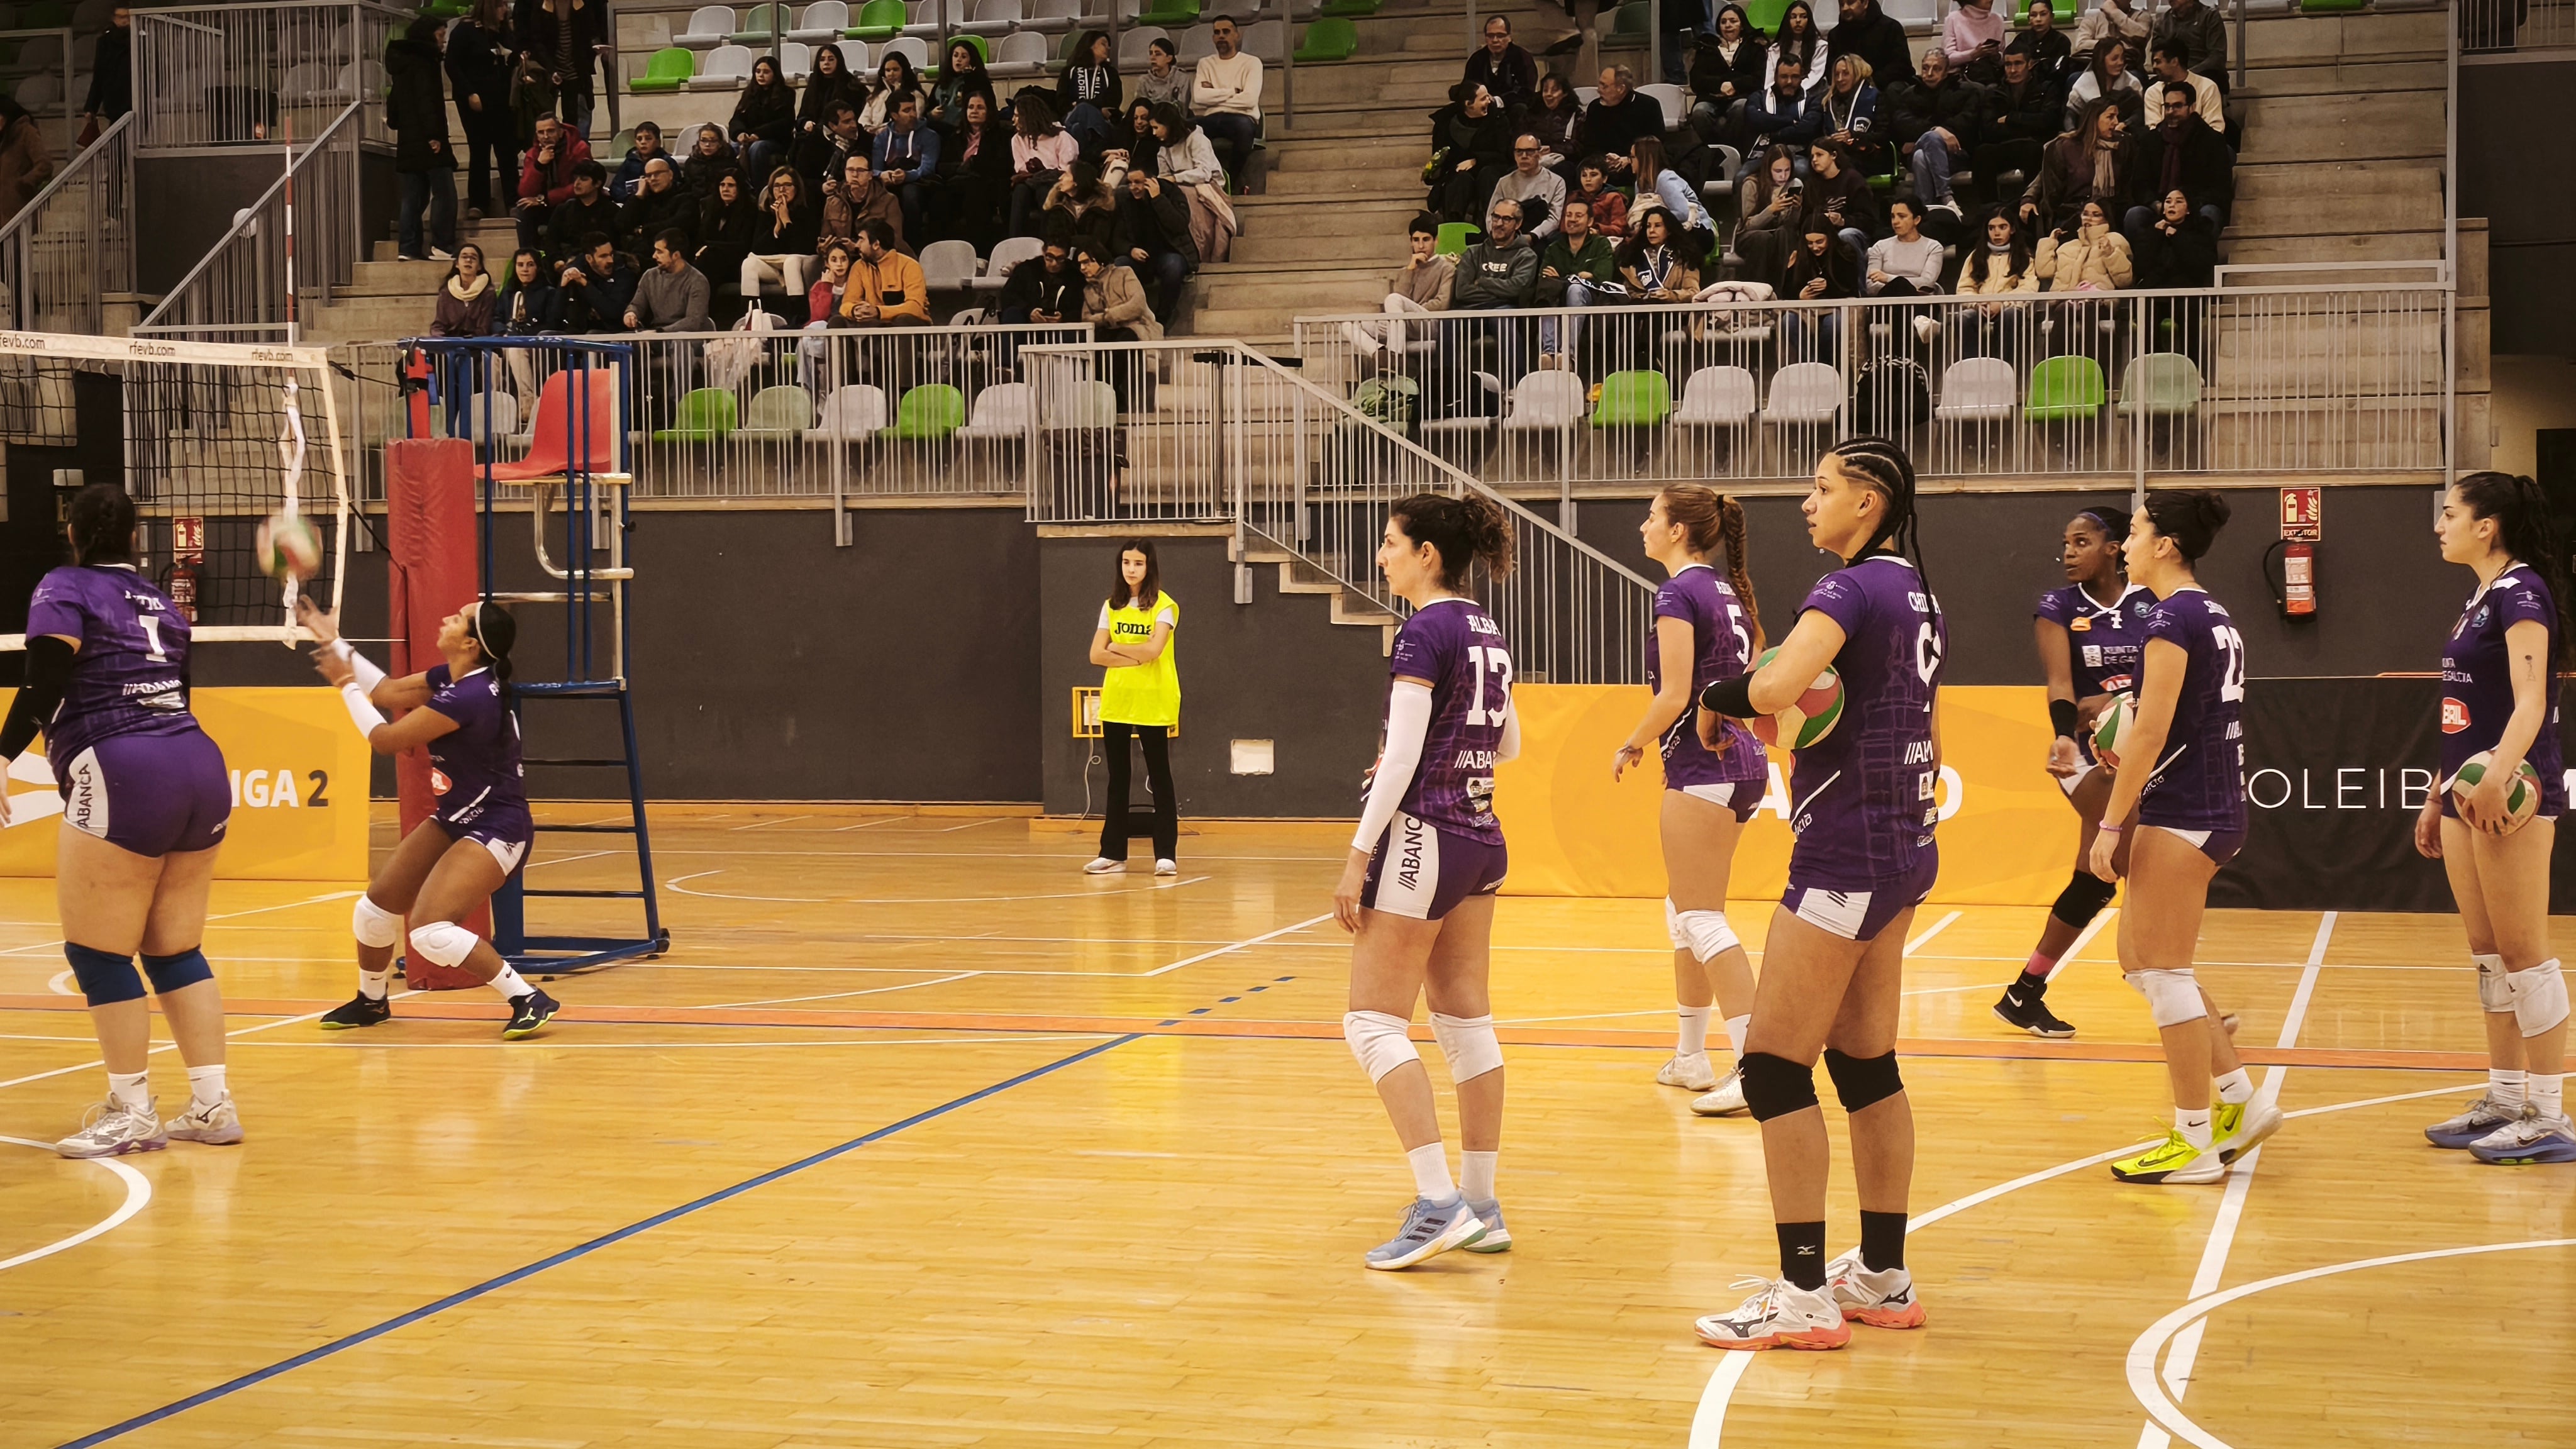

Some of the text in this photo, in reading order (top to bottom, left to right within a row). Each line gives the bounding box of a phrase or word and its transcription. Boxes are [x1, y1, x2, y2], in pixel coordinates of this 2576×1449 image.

[0, 334, 46, 350] fevb.com
[129, 341, 176, 357] rfevb.com
[138, 614, 167, 663] 1
[1466, 614, 1502, 637] ALBA
[1726, 604, 1750, 665] 5
[2211, 625, 2245, 703] 22
[1466, 645, 1513, 728] 13
[231, 769, 329, 808] IGA 2
[2248, 768, 2433, 809] OLEIB
